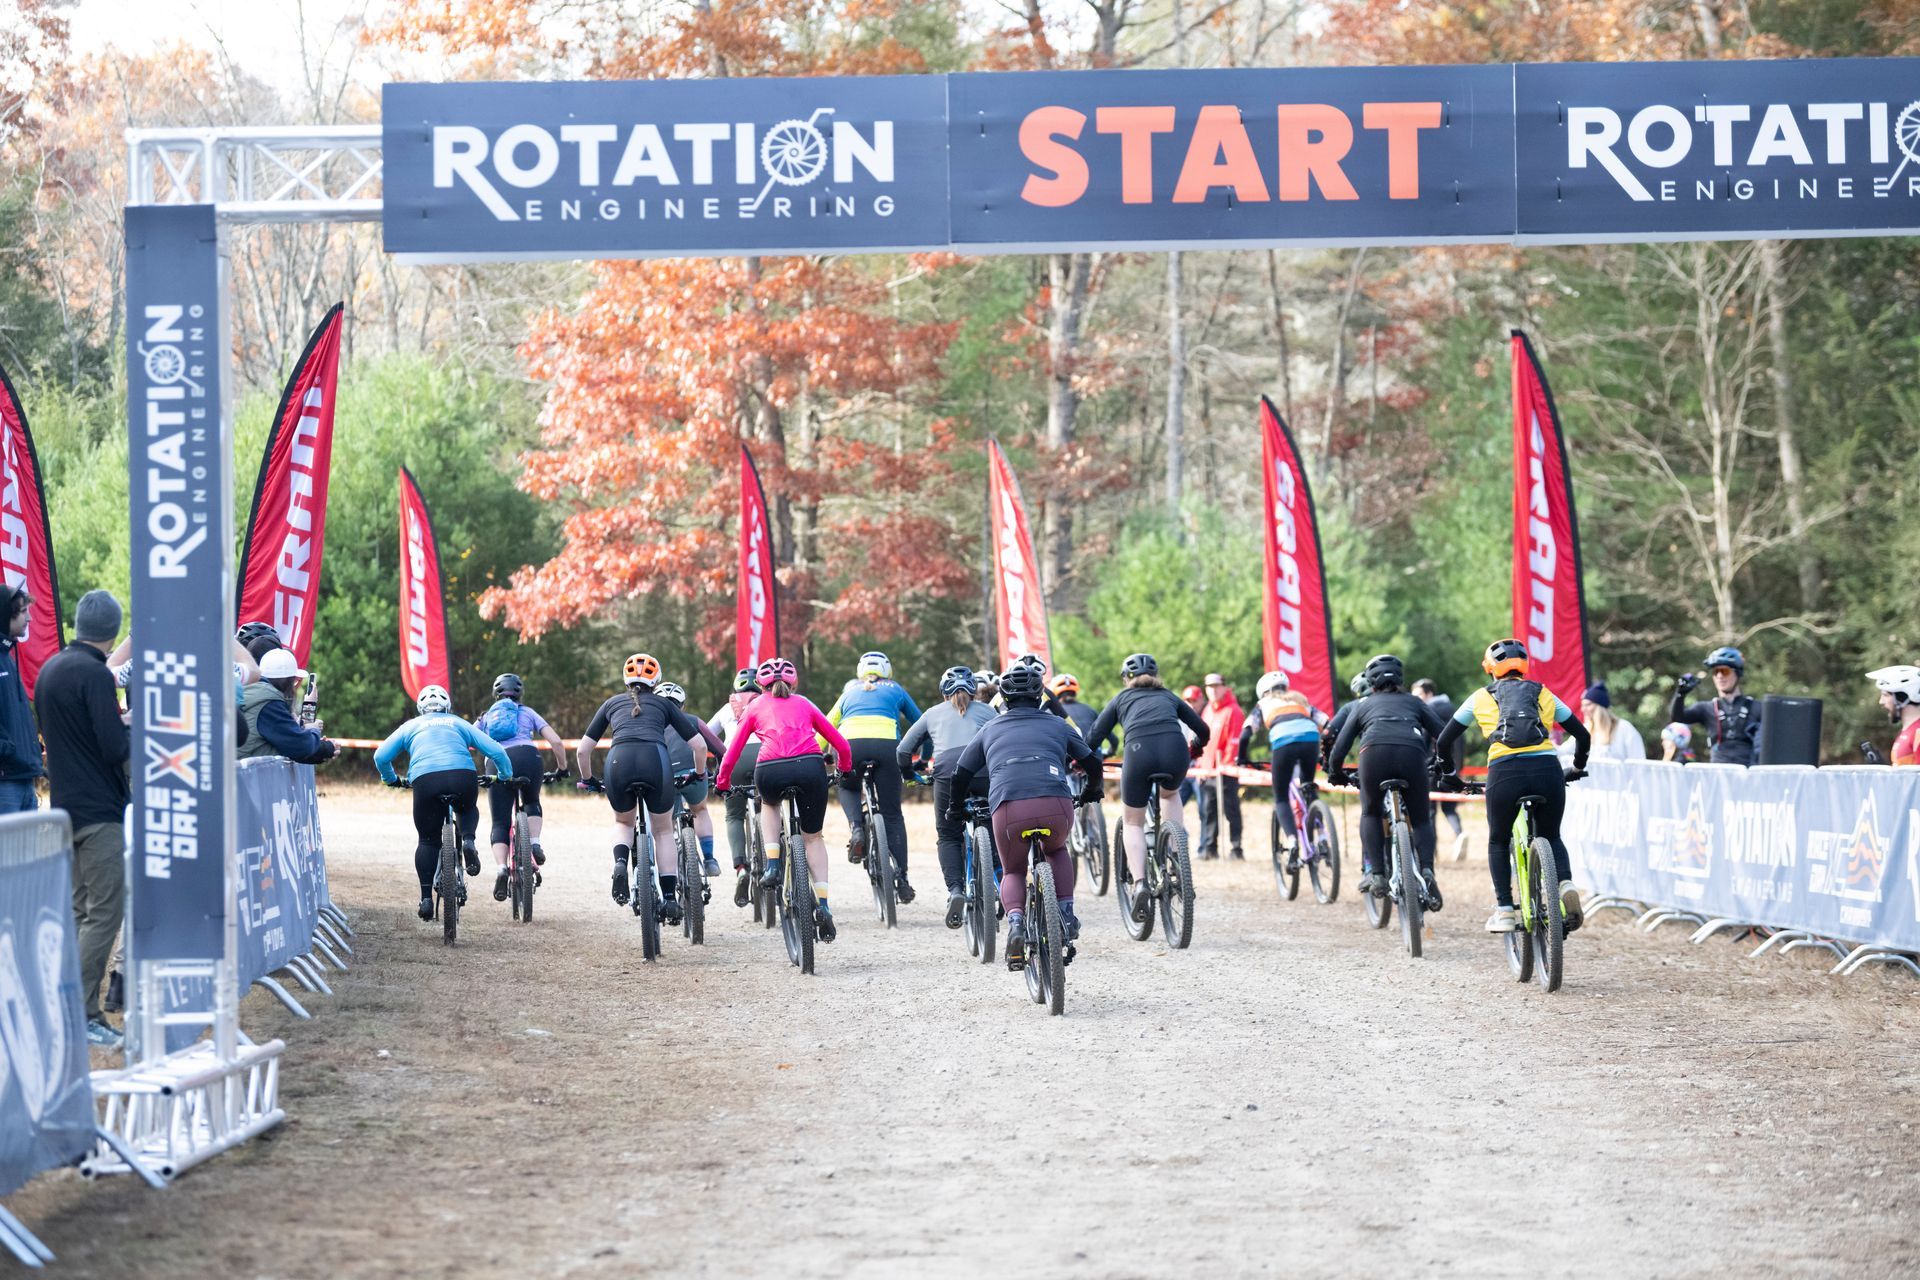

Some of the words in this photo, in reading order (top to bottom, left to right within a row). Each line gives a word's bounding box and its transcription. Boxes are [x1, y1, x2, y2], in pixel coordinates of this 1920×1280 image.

[433, 109, 895, 221] ROTATION
[527, 194, 895, 221] ENGINEERING
[1018, 102, 1442, 207] START
[138, 304, 207, 579] ROTATION
[189, 304, 207, 524] ENGINEERING
[273, 386, 322, 650] SRAM
[1274, 457, 1303, 674] SRAM
[144, 786, 171, 880] RACE
[172, 788, 198, 860] DAY
